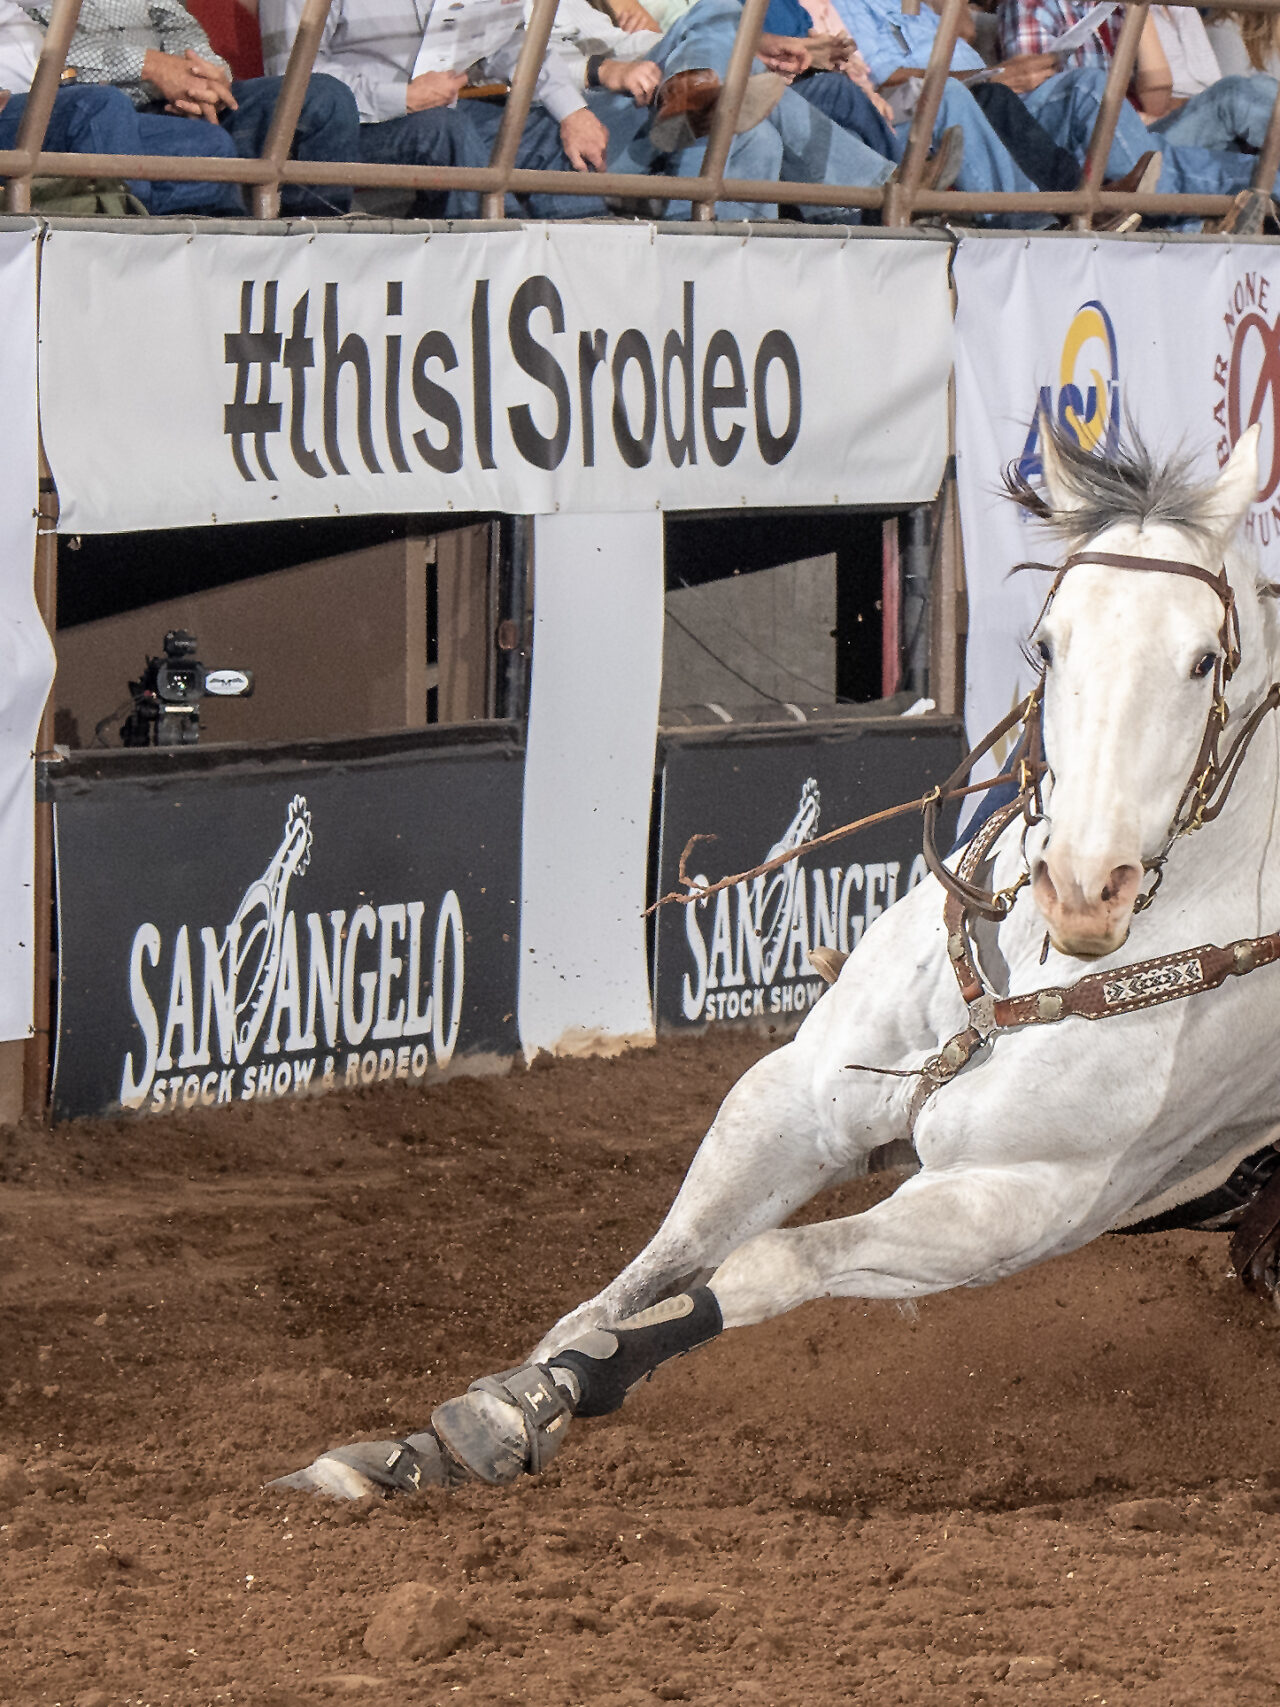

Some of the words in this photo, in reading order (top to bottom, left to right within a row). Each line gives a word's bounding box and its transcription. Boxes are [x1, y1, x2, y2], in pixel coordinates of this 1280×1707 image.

[224, 274, 803, 483] #thisISrodeo
[1214, 354, 1229, 470] BAR
[1223, 271, 1270, 342] NONE
[120, 922, 241, 1109] SAN
[263, 889, 464, 1070] ANGELO
[683, 873, 767, 1021] SAN
[783, 853, 929, 978] ANGE
[705, 987, 765, 1021] STOCK
[770, 981, 824, 1014] SHOW
[152, 1068, 236, 1113] STOCK
[240, 1057, 316, 1101] SHOW
[321, 1055, 336, 1089] &
[345, 1043, 428, 1086] RODEO
